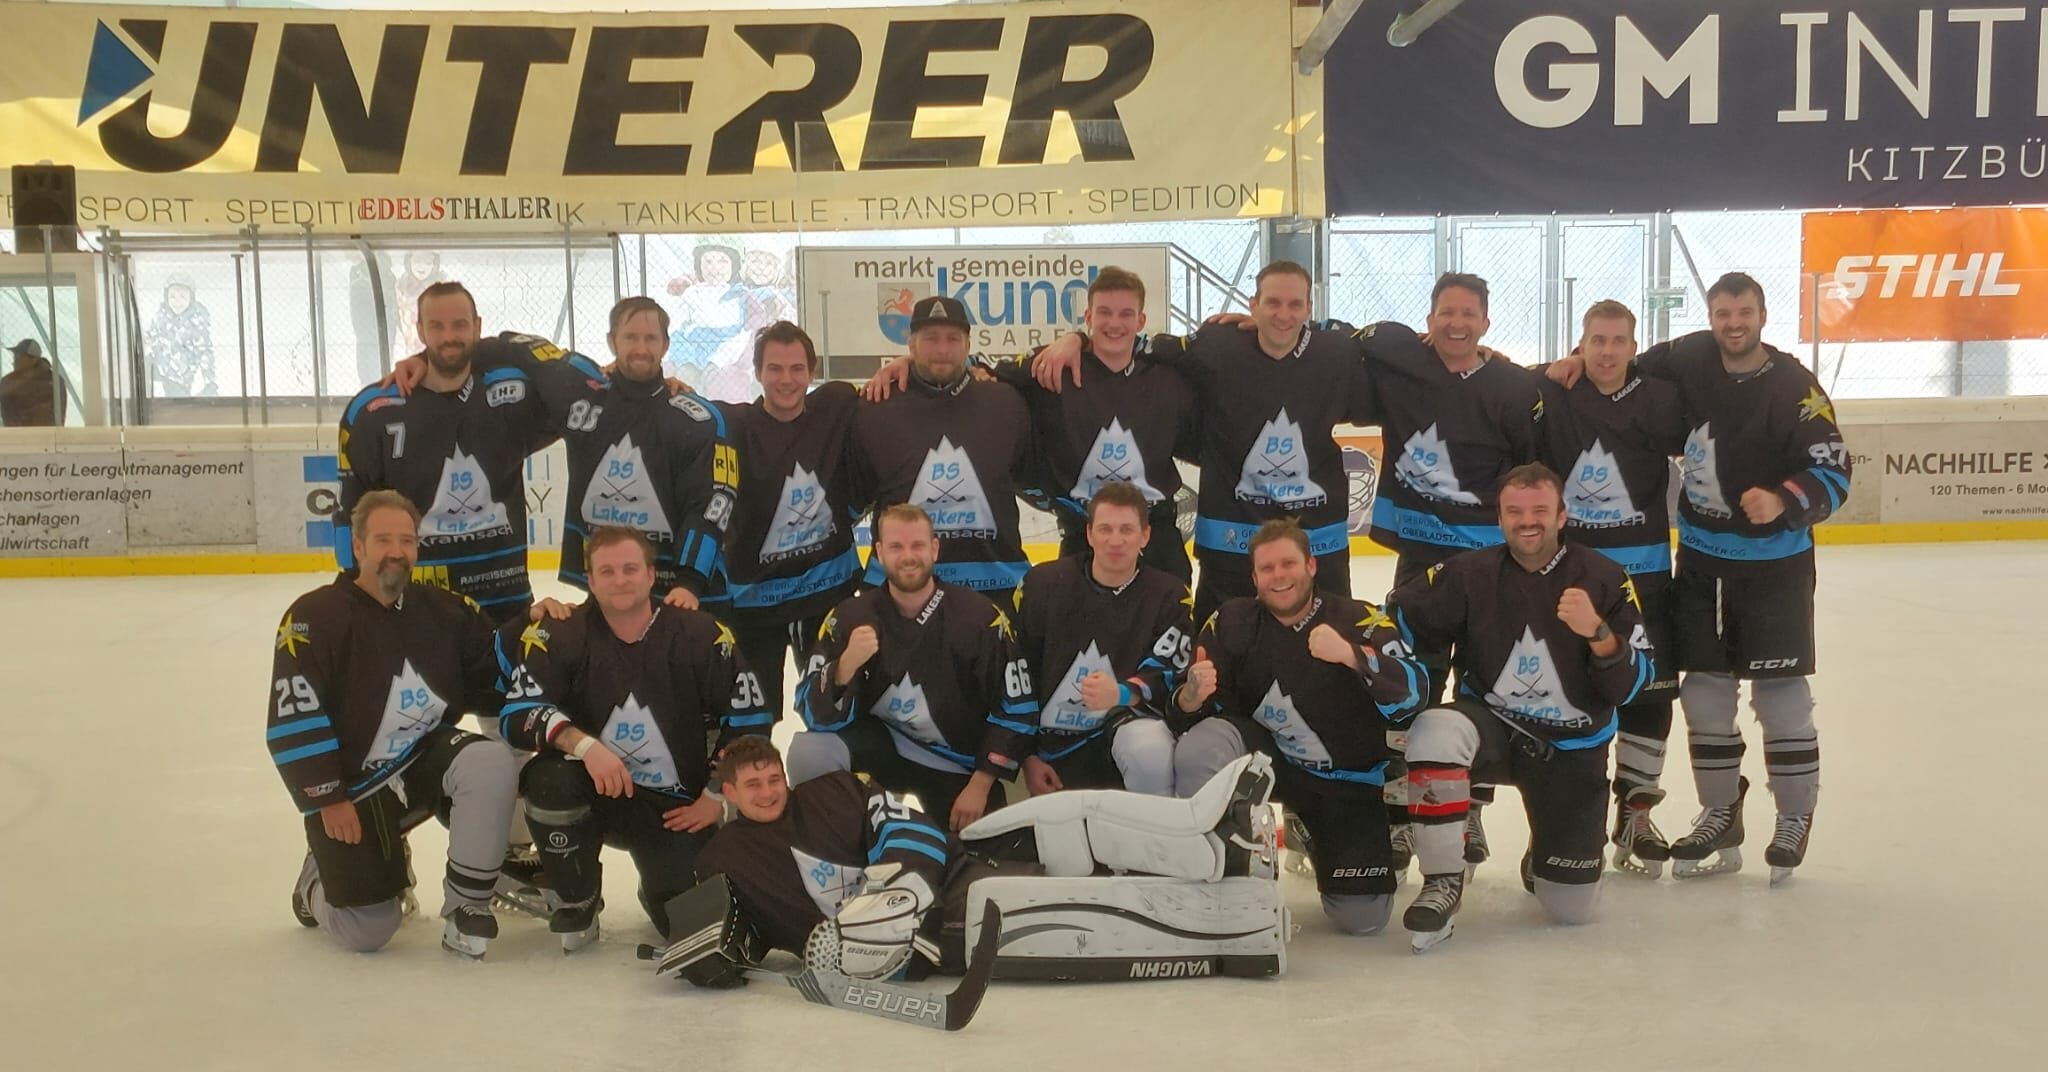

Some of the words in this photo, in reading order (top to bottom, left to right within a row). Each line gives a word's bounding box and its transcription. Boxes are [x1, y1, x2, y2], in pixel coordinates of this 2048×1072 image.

[1494, 14, 1719, 128] GM
[1777, 7, 2048, 122] INT
[98, 14, 1154, 175] UNTERER
[1848, 137, 2046, 182] KITZBÜ
[226, 199, 360, 225] SPEDITI
[358, 197, 553, 221] EDELSTHALER
[617, 199, 828, 226] TANKSTELLE
[858, 190, 1058, 220] TRANSPORT
[1088, 182, 1259, 214] SPEDITION
[854, 256, 935, 278] markt
[951, 254, 1085, 283] gemeinde
[1834, 252, 2021, 299] STIHL
[385, 422, 406, 459] 7
[1100, 442, 1128, 460] BS
[1264, 435, 1294, 455] BS
[44, 463, 66, 477] für
[71, 461, 244, 479] Leergutmanagement
[607, 459, 634, 480] BS
[931, 461, 960, 481] BS
[1579, 464, 1610, 483] BS
[1885, 452, 2033, 475] NACHHILFE
[790, 486, 816, 507] BS
[1930, 485, 1951, 496] 120
[1956, 484, 2005, 496] Themen
[2016, 484, 2024, 494] 6
[591, 503, 649, 525] Lakers
[930, 508, 977, 524] akers
[915, 589, 945, 626] LAKERS
[1076, 666, 1089, 683] B
[1517, 655, 1541, 675] BS
[1749, 657, 1799, 671] CCM
[1004, 658, 1033, 698] 66
[275, 675, 320, 718] 29
[400, 688, 430, 711] BS
[731, 672, 765, 710] 33
[1263, 705, 1288, 724] BS
[1509, 702, 1563, 719] akers
[615, 722, 646, 742] BS
[810, 860, 836, 888] BS
[1129, 960, 1211, 978] VAUGHN
